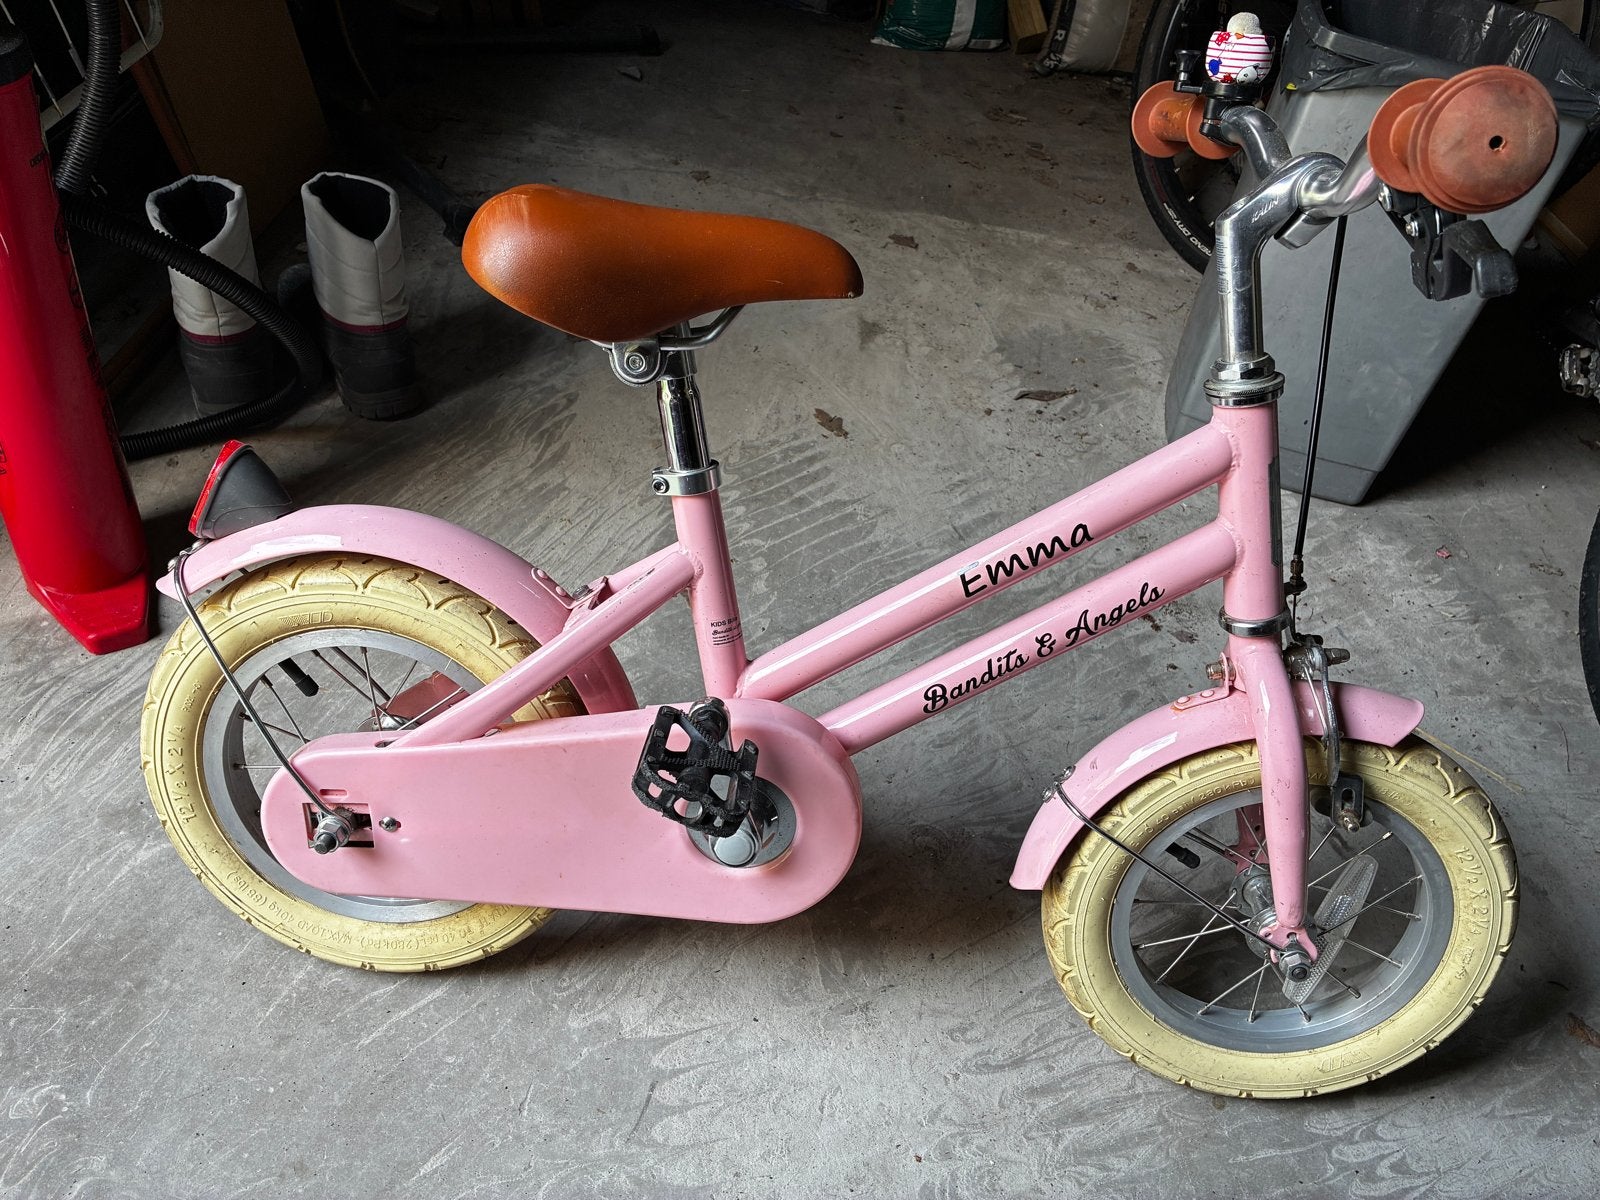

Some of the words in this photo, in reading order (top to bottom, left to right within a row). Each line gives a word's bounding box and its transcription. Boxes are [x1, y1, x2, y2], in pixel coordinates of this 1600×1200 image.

[959, 523, 1094, 598] Emma
[923, 648, 1029, 714] Bandits
[1035, 633, 1056, 658] &
[1065, 582, 1165, 647] Angels
